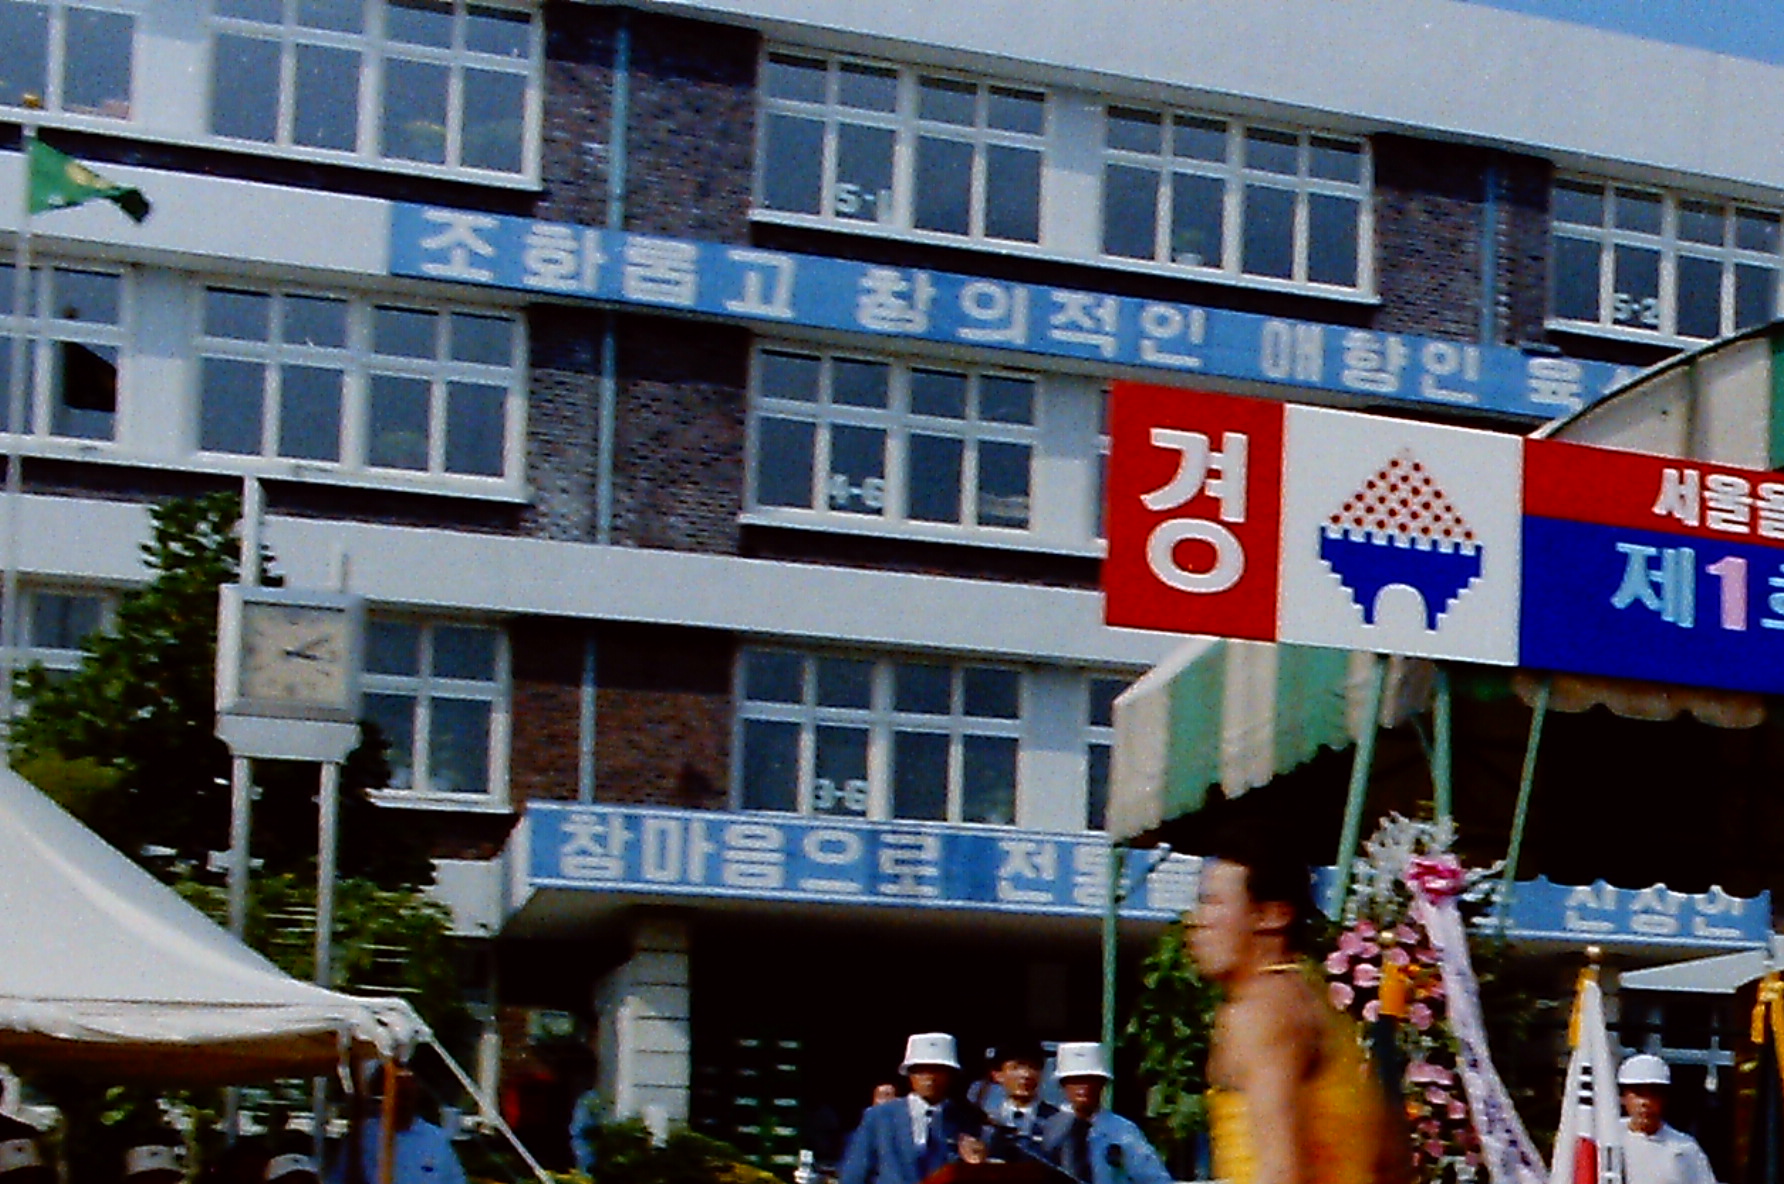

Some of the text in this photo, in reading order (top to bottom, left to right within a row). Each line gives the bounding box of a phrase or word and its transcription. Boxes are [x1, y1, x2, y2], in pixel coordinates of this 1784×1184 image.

[420, 209, 796, 318] 조화롭고
[856, 268, 1206, 368] 창의적인
[1139, 427, 1248, 593] 경
[558, 812, 941, 899] 참마음으로
